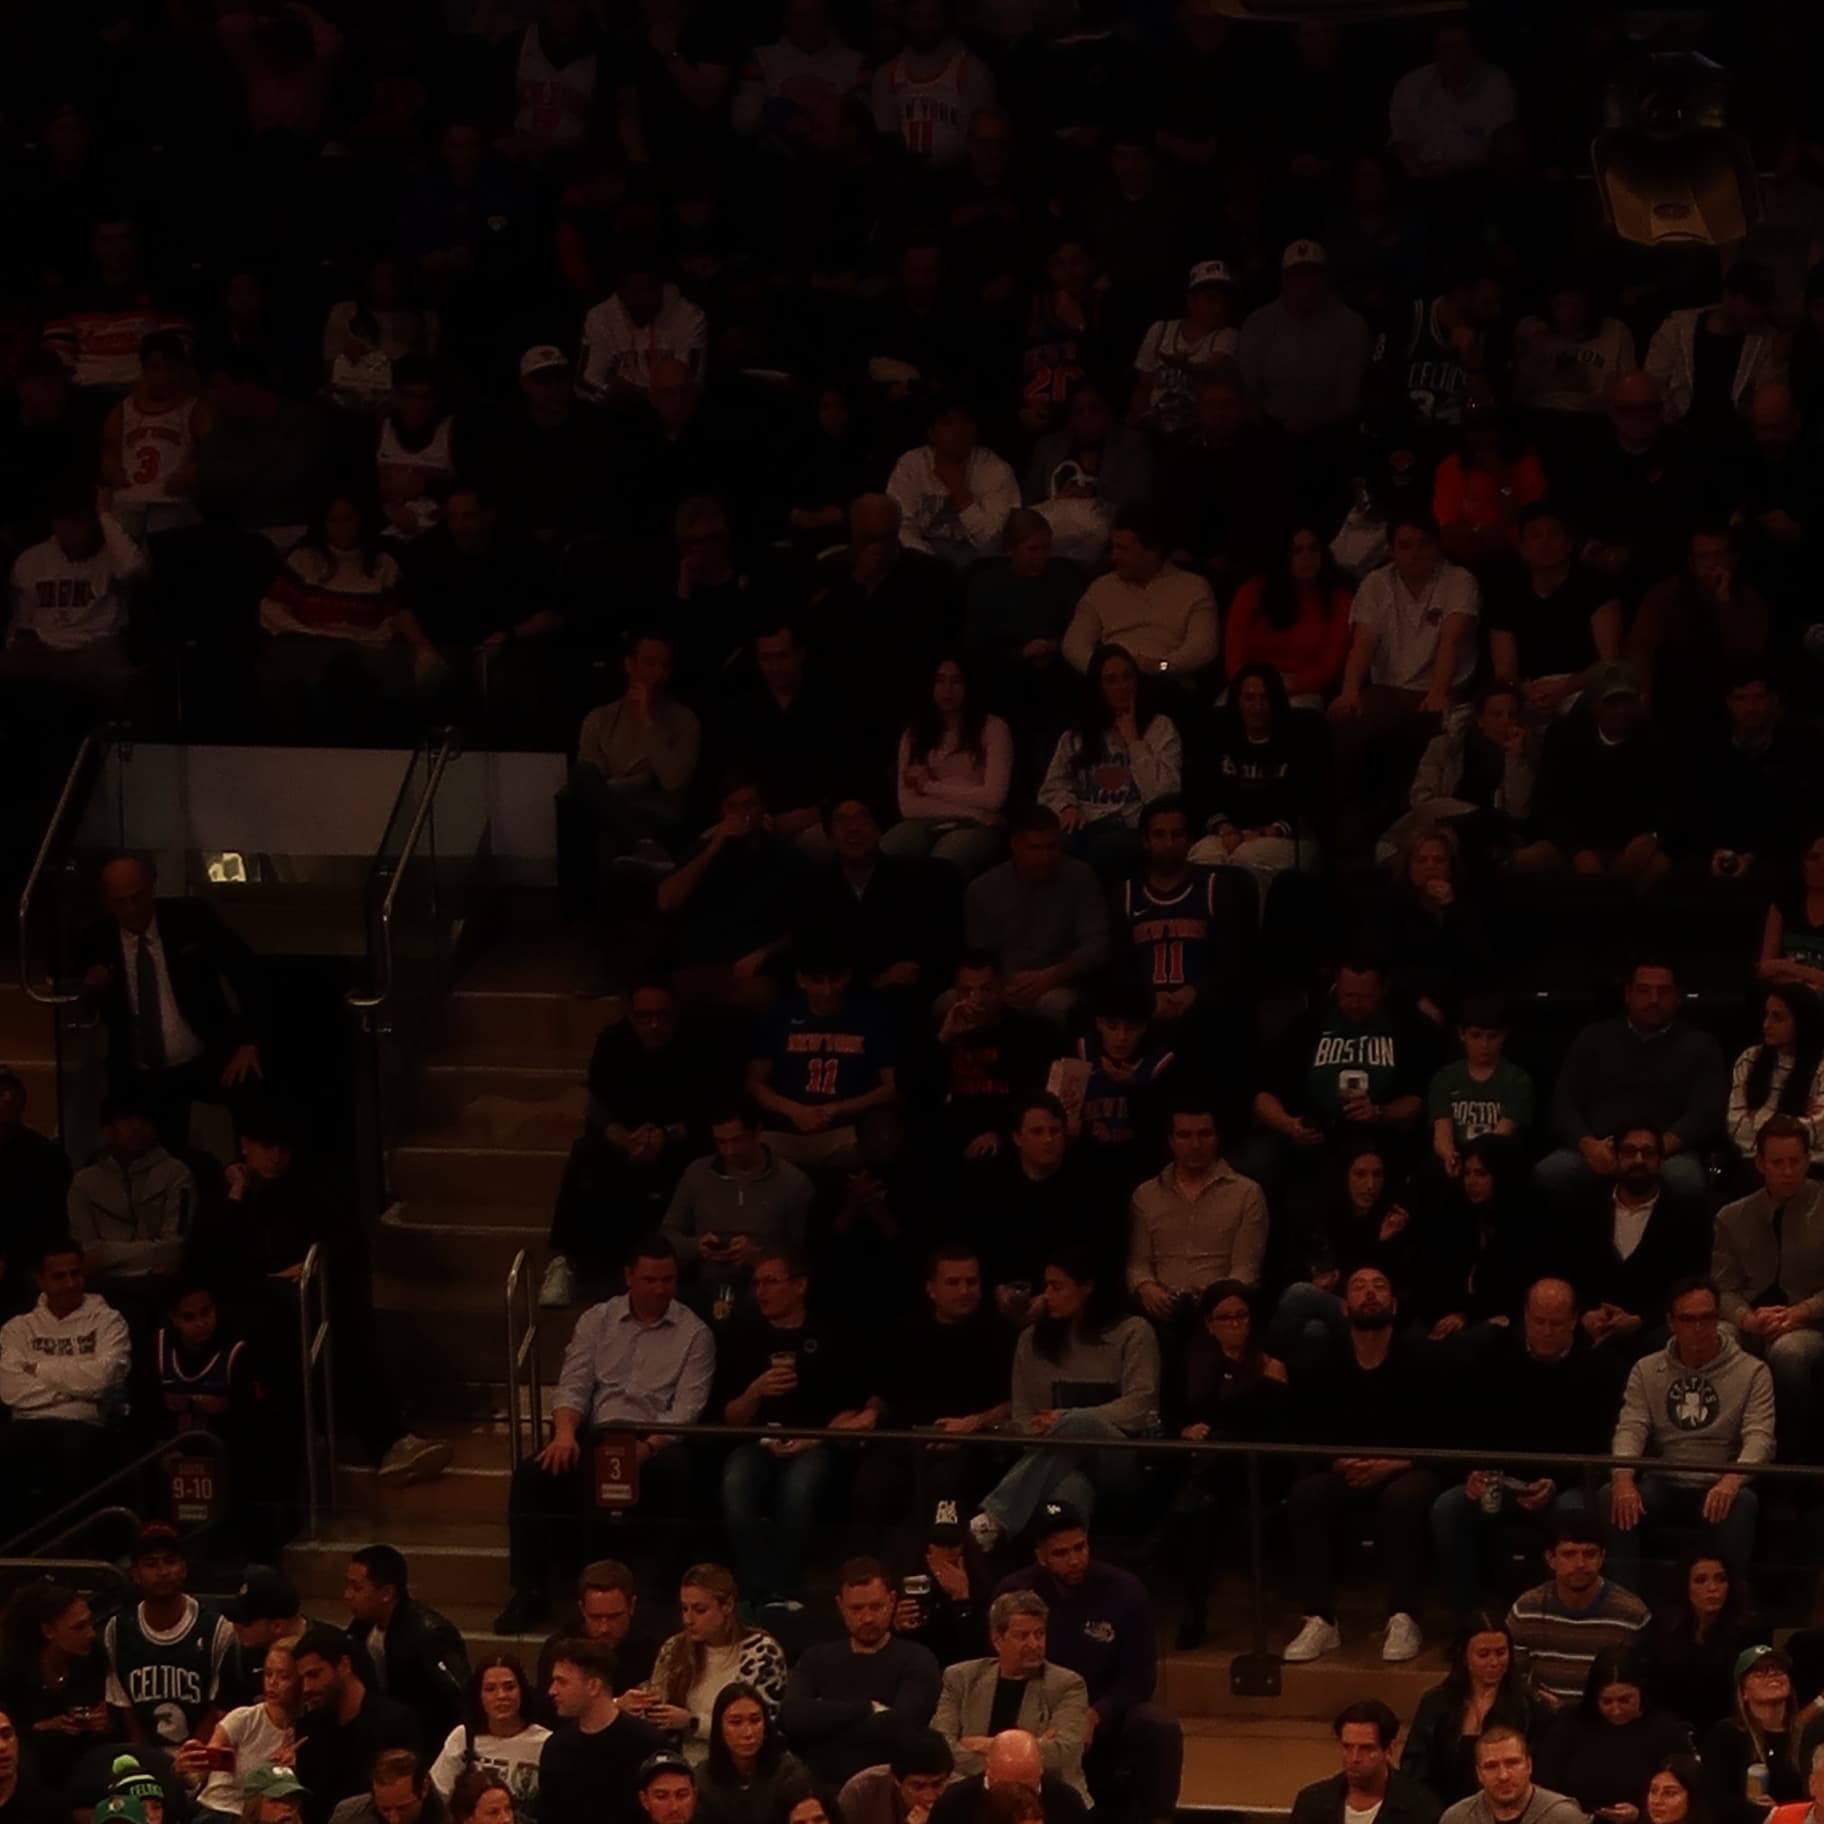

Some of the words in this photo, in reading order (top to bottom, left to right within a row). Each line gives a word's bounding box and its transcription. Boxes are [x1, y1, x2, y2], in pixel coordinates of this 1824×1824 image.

[134, 444, 160, 484] 3
[1152, 941, 1185, 985] 11
[1313, 1035, 1396, 1068] BOSTON
[608, 1458, 622, 1482] 3
[172, 1476, 215, 1501] 9-10
[129, 1664, 202, 1704] CELTICS
